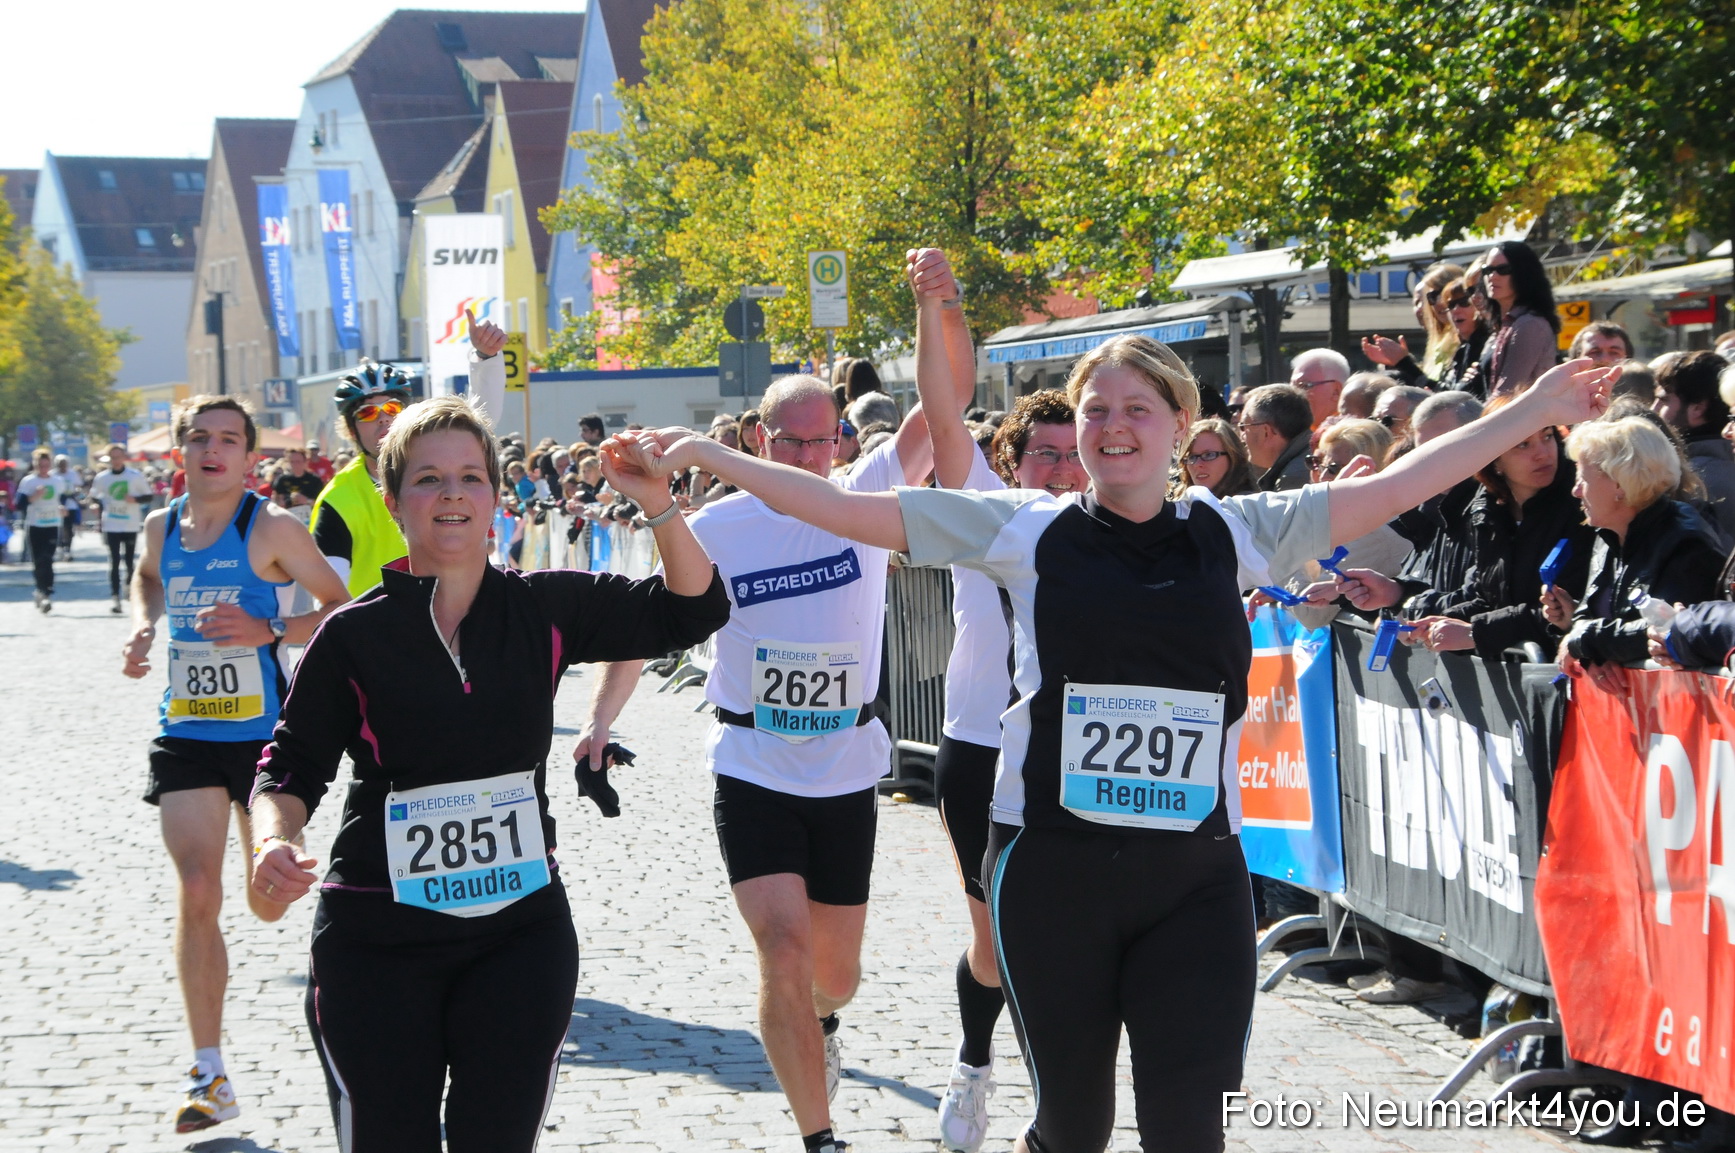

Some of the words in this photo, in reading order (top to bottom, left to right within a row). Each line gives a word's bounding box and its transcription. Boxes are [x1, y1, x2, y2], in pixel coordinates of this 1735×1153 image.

[432, 248, 498, 265] swn
[337, 237, 353, 300] RUPPERT
[753, 559, 854, 595] STAEDTLER
[174, 590, 241, 607] NAGEL
[769, 649, 818, 662] PFLEIDERER
[187, 663, 239, 696] 830
[763, 667, 847, 707] 2621
[188, 697, 240, 715] Daniel
[1088, 710, 1157, 719] AKTIENGESELLSCHAFT
[1089, 696, 1157, 712] PFLEIDERER
[1173, 706, 1210, 718] BOCK
[772, 709, 840, 731] Markus
[1081, 721, 1203, 779] 2297
[1096, 778, 1186, 814] Regina
[1355, 694, 1519, 880] THULE
[409, 793, 476, 812] PFLEIDERER
[410, 806, 477, 820] AKTIENGESELLSCHAFT
[406, 810, 523, 874] 2851
[423, 868, 523, 903] Claudia
